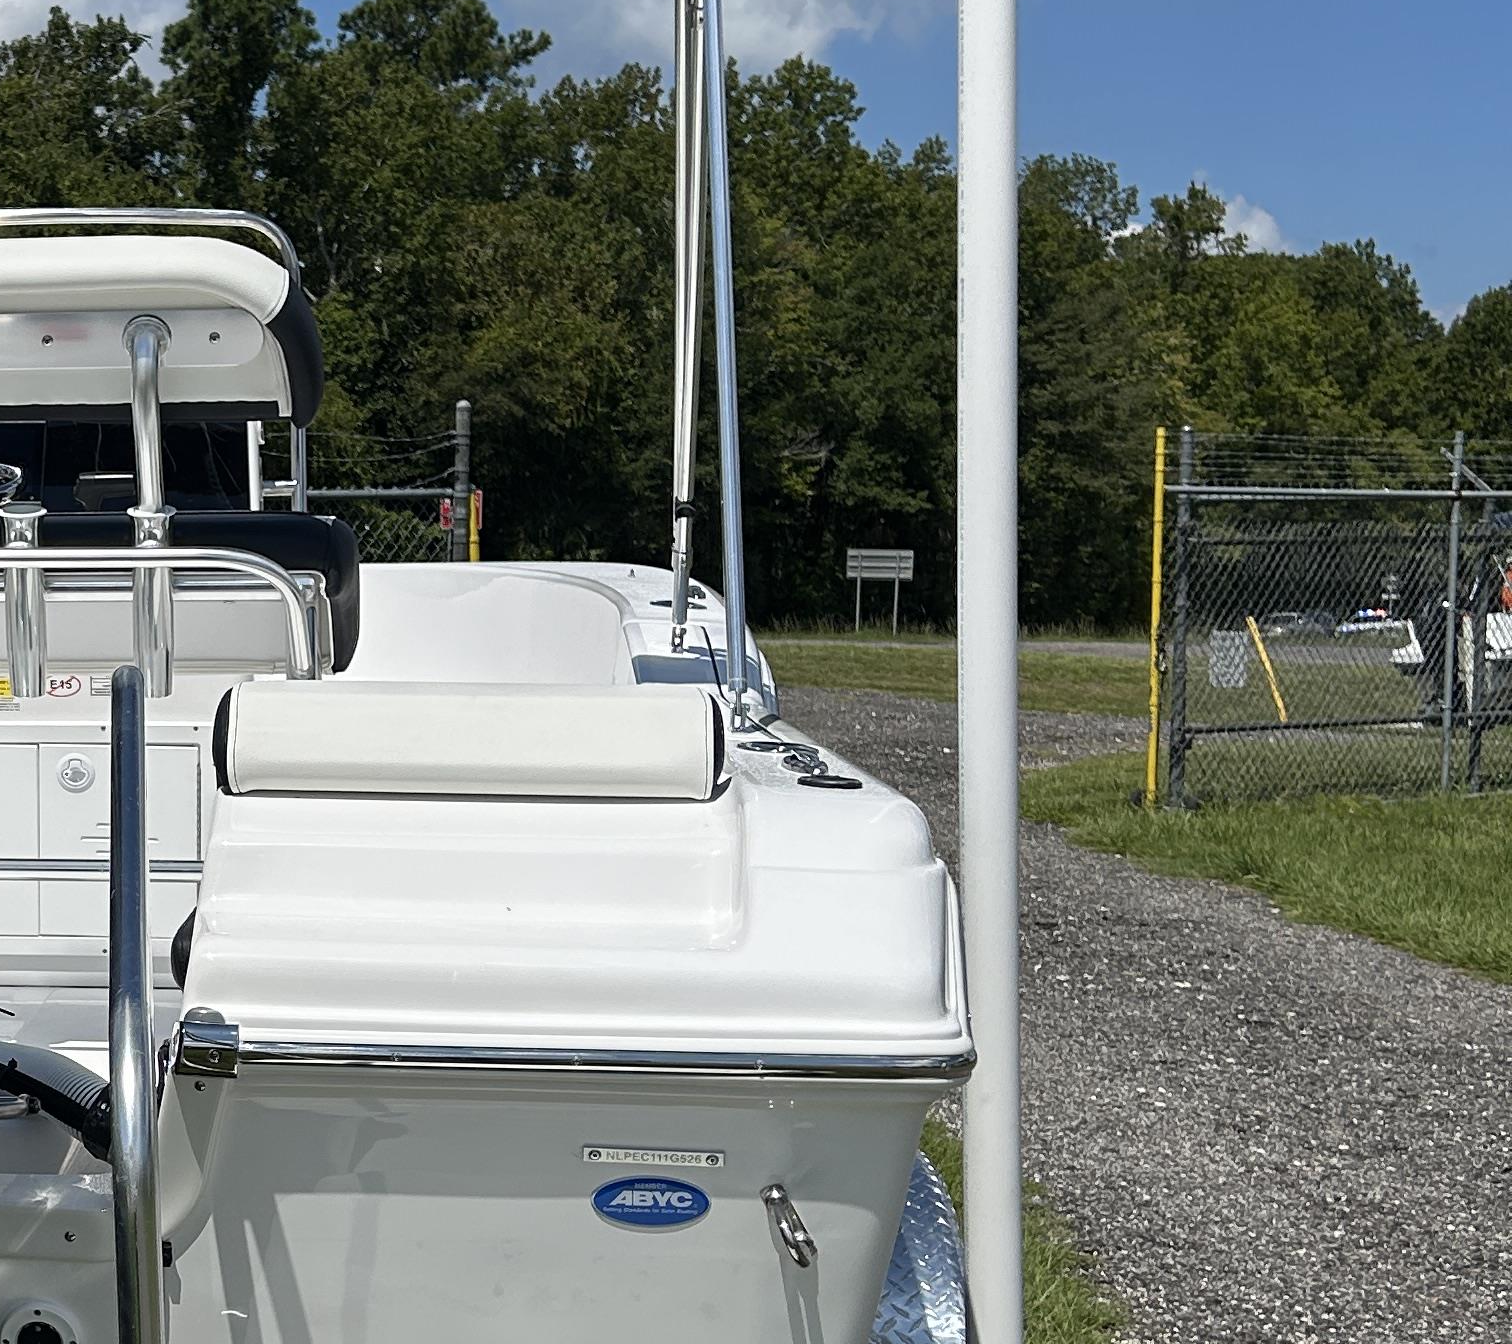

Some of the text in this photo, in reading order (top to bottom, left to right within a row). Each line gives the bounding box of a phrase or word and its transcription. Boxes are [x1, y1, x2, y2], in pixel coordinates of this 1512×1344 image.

[50, 679, 73, 690] E15
[606, 1151, 701, 1163] NLPEC111G526
[609, 1190, 693, 1207] ABYC
